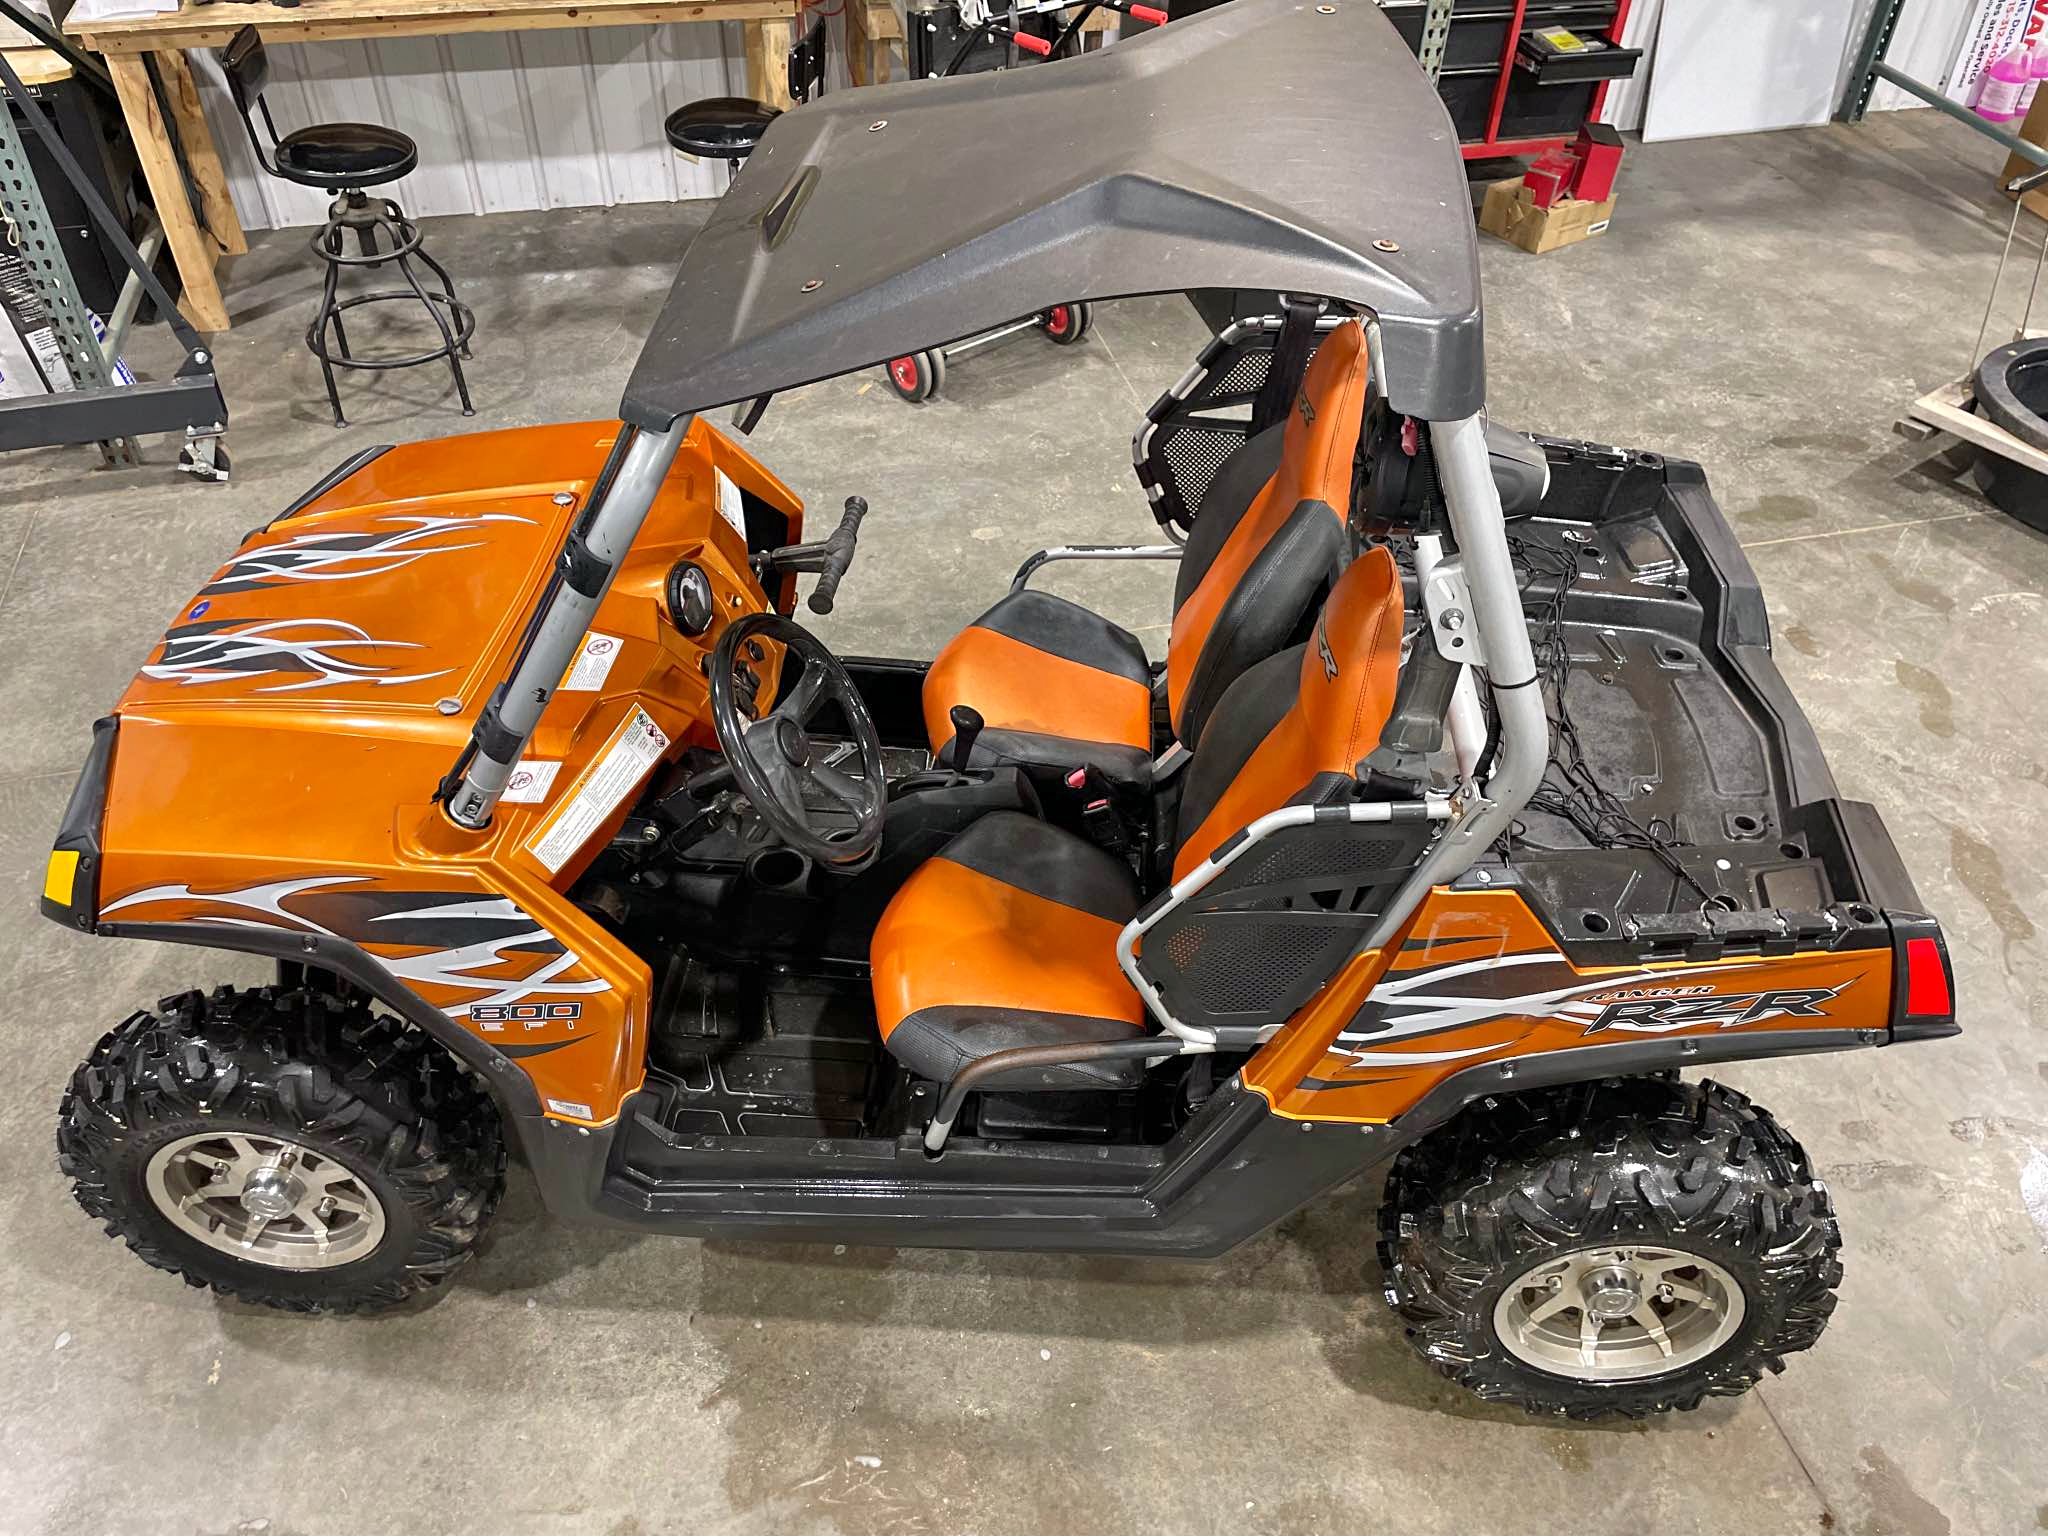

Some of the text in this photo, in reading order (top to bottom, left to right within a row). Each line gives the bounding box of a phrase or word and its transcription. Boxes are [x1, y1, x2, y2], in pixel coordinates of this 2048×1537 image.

[1967, 0, 2006, 85] les and Service
[1983, 0, 2017, 73] 15-312-4020
[1583, 985, 1716, 1002] RANGER
[470, 1001, 583, 1022] 800
[480, 1020, 575, 1032] EFI
[1580, 988, 1839, 1038] RZR
